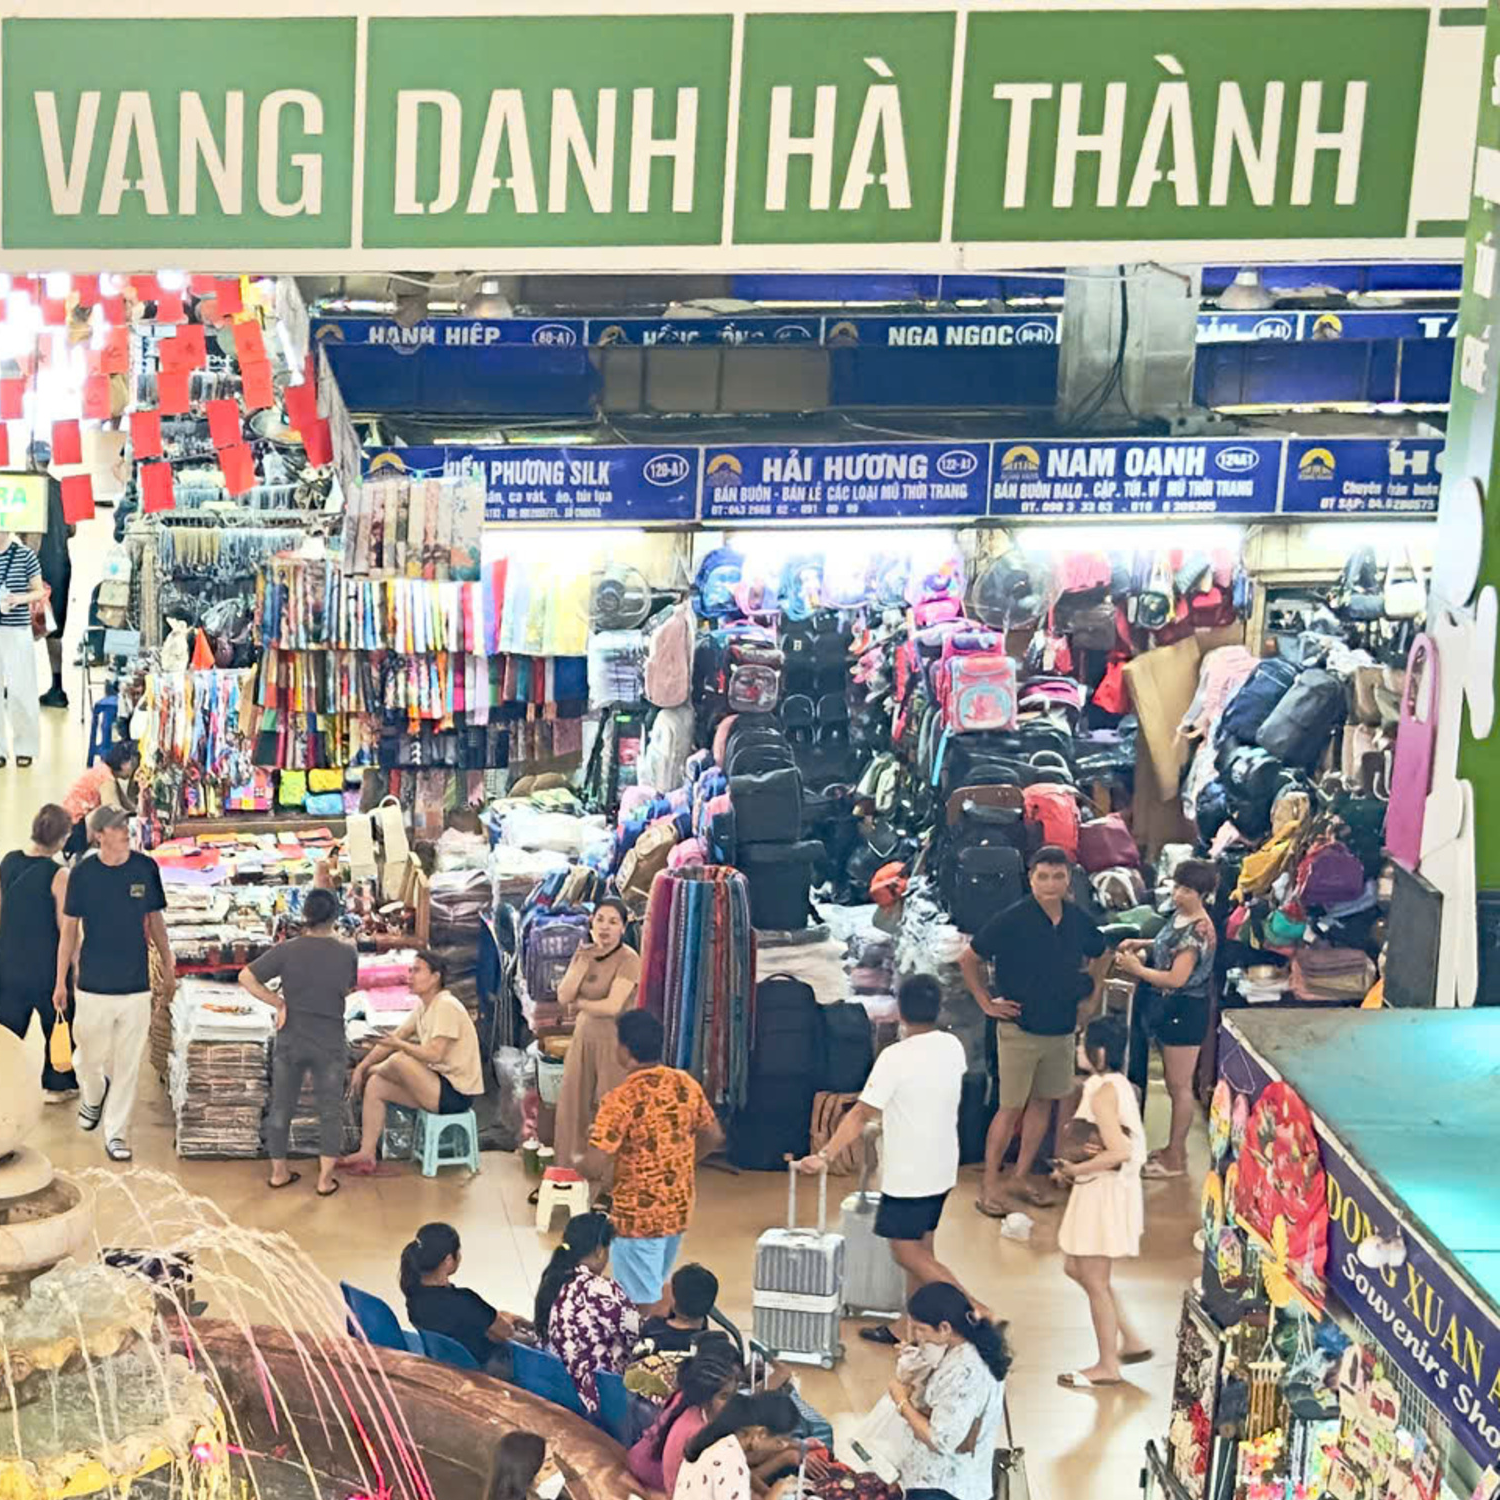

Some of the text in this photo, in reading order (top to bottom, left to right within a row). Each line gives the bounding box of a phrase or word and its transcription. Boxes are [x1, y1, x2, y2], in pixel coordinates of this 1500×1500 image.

[34, 54, 1366, 217] VANG DANH HÀ THÀNH
[889, 326, 939, 346] NGA
[491, 459, 564, 486] PHƯƠNG
[570, 459, 609, 486] SILK
[762, 449, 928, 484] HẢI HƯƠNG
[1047, 446, 1206, 478] NAM OANH
[713, 486, 737, 503] BÁN
[827, 482, 850, 500] CÁC
[931, 484, 968, 499] TRANG
[994, 480, 1017, 499] BÁN
[1216, 480, 1254, 497] TRANG
[1342, 1252, 1450, 1390] Souvenirs
[1403, 1262, 1485, 1387] XUAN
